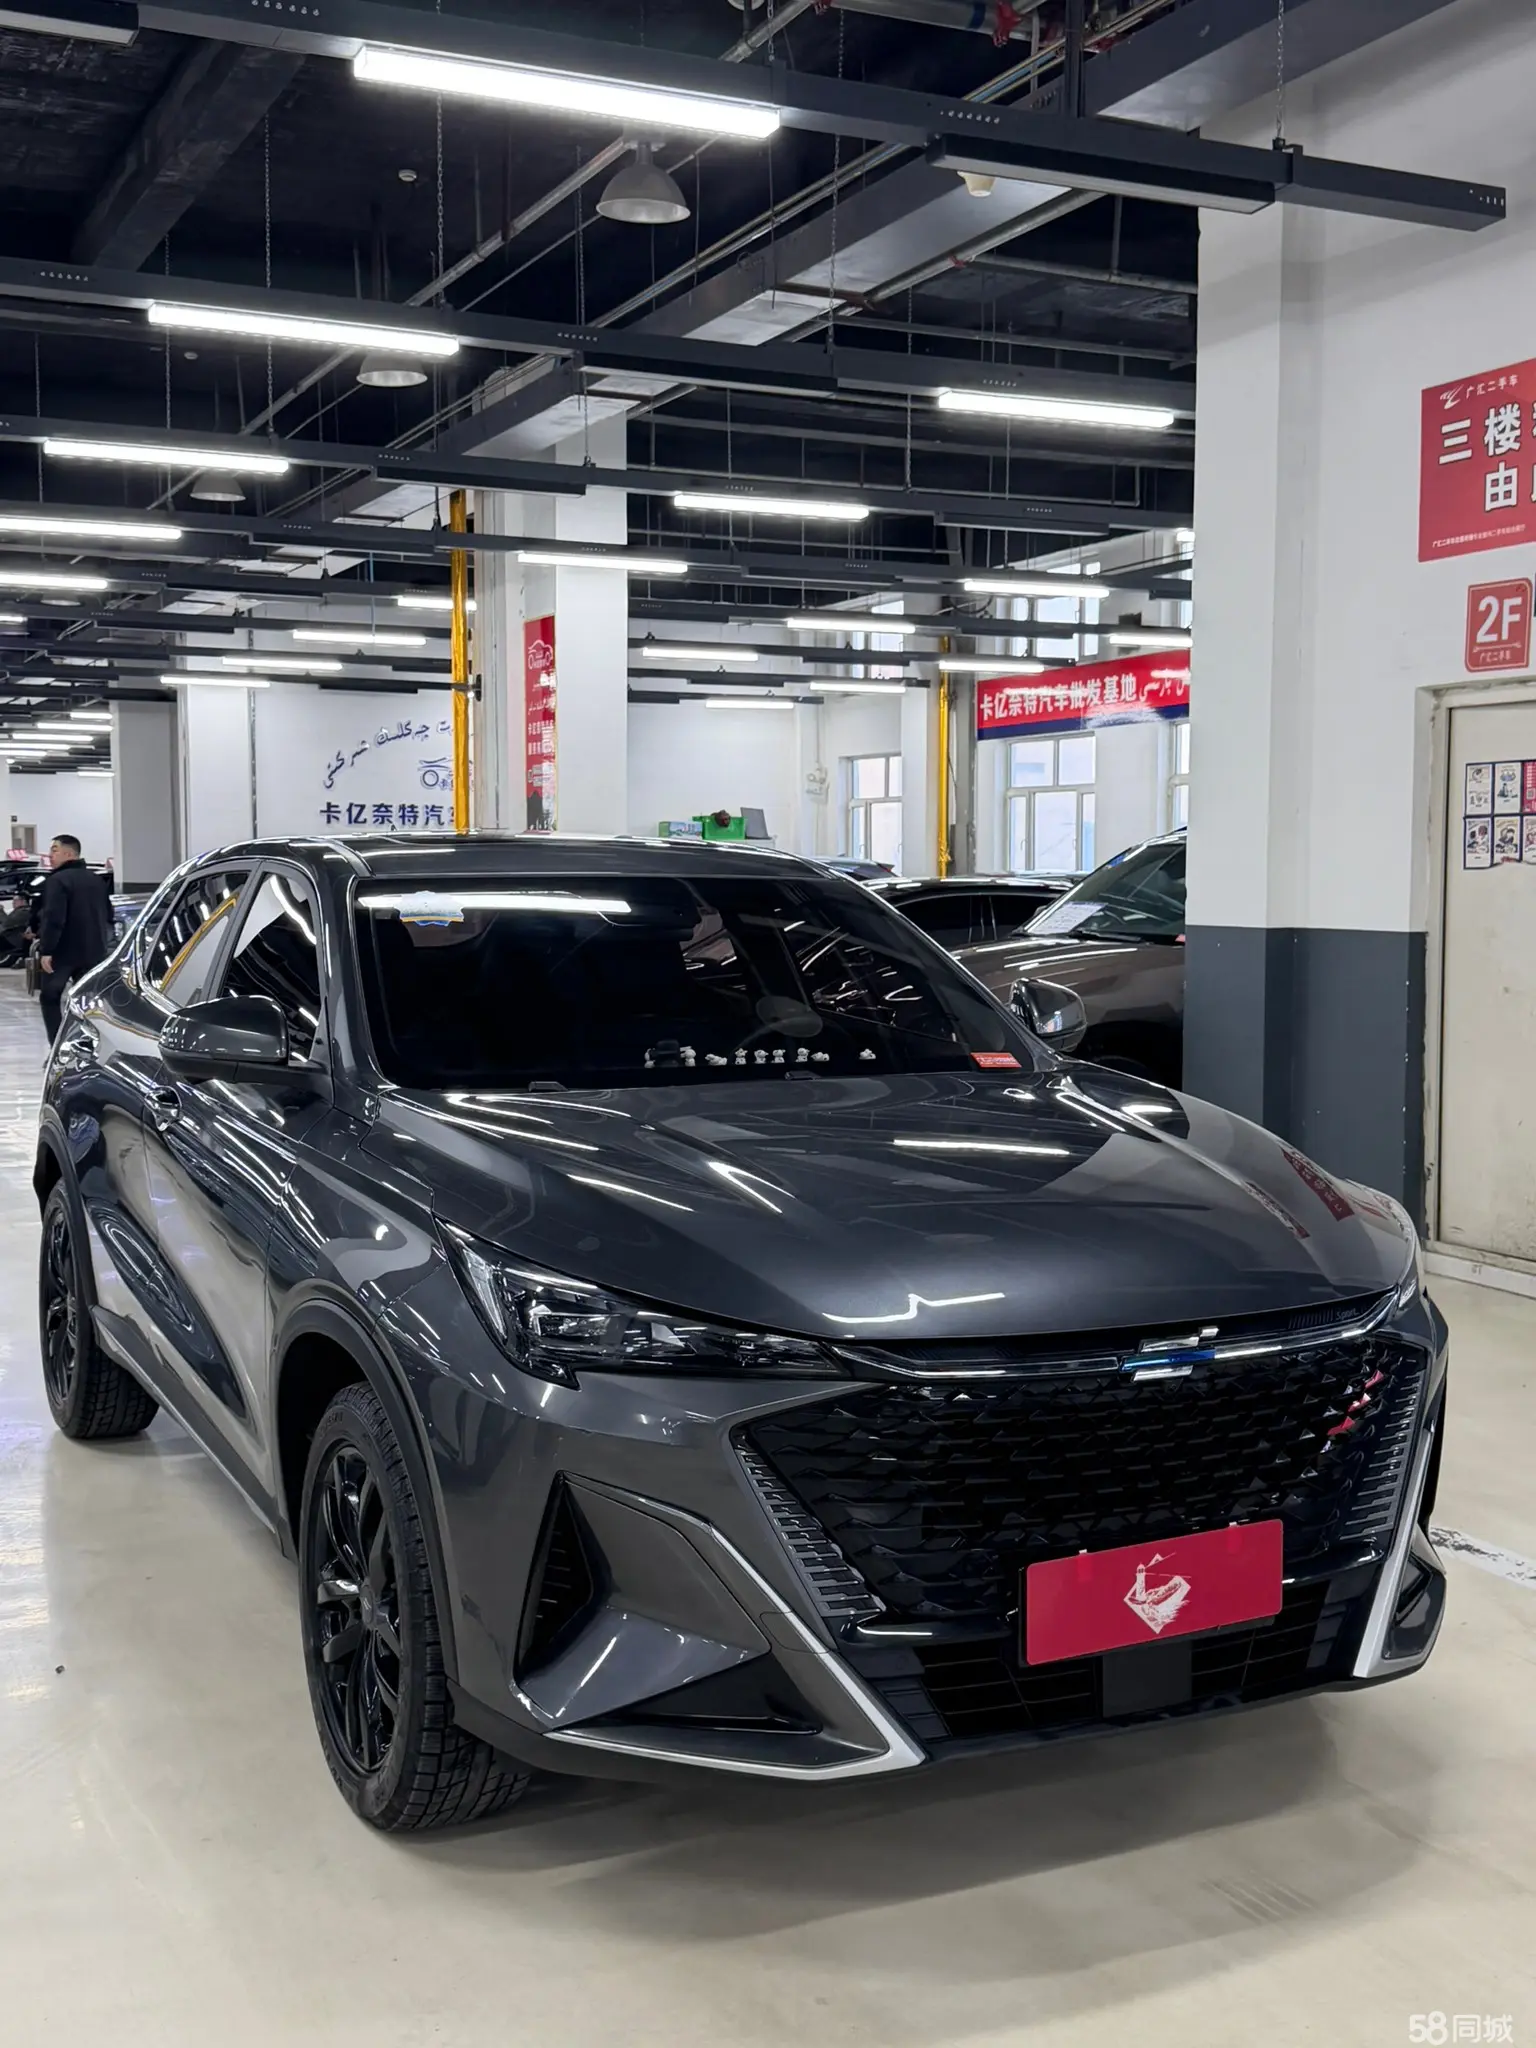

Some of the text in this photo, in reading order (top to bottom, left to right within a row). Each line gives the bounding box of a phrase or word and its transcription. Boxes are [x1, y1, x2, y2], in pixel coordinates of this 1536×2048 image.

[1465, 374, 1519, 400] 广汇二手车
[1438, 400, 1536, 465] 三楼
[1475, 595, 1522, 644] 2F
[980, 673, 1137, 721] 卡亿奈特汽车批发基地
